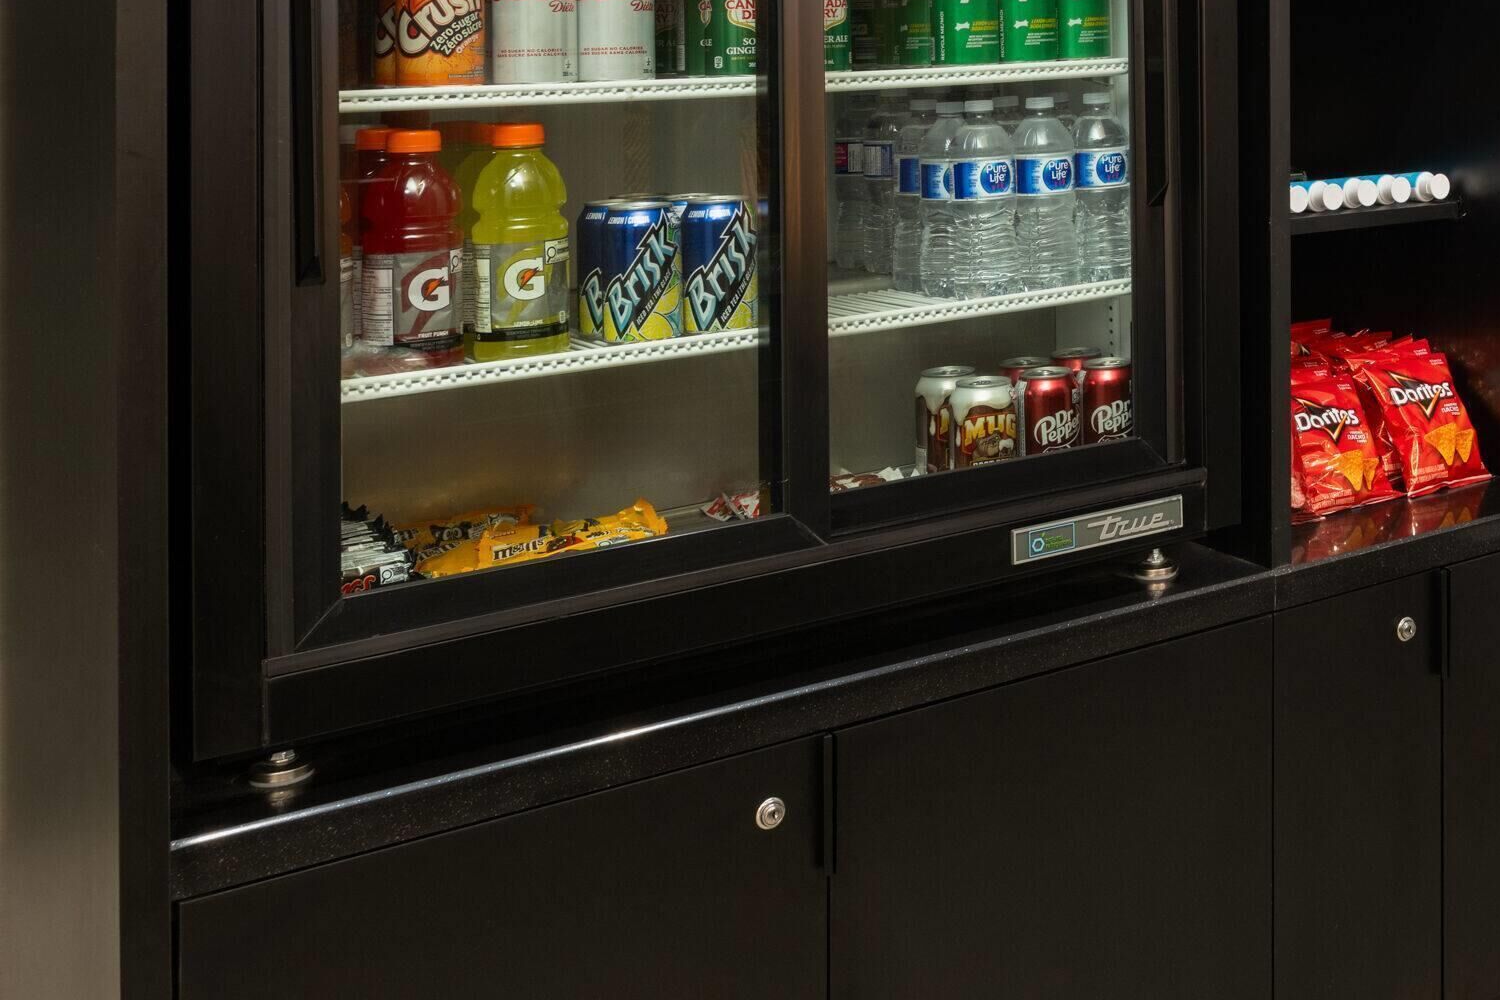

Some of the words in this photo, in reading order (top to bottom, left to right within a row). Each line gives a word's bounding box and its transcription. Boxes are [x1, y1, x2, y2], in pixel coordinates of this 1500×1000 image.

[725, 0, 755, 10] CAN
[726, 46, 756, 55] GINGE
[1048, 161, 1069, 171] Pure
[1101, 154, 1122, 165] Pure
[986, 163, 1007, 174] Pure
[1051, 170, 1066, 180] Life
[1104, 164, 1120, 174] Life
[989, 172, 1005, 183] Life
[608, 216, 625, 224] LEMON
[504, 257, 545, 300] G
[408, 266, 450, 311] G
[1389, 382, 1453, 405] Doritos
[1111, 399, 1131, 415] Dr
[1056, 409, 1074, 424] Dr
[1097, 405, 1132, 435] Pepp
[1295, 409, 1359, 431] Doritos
[964, 413, 1016, 447] MUG
[1039, 415, 1080, 447] Pepper
[1087, 512, 1169, 540] true
